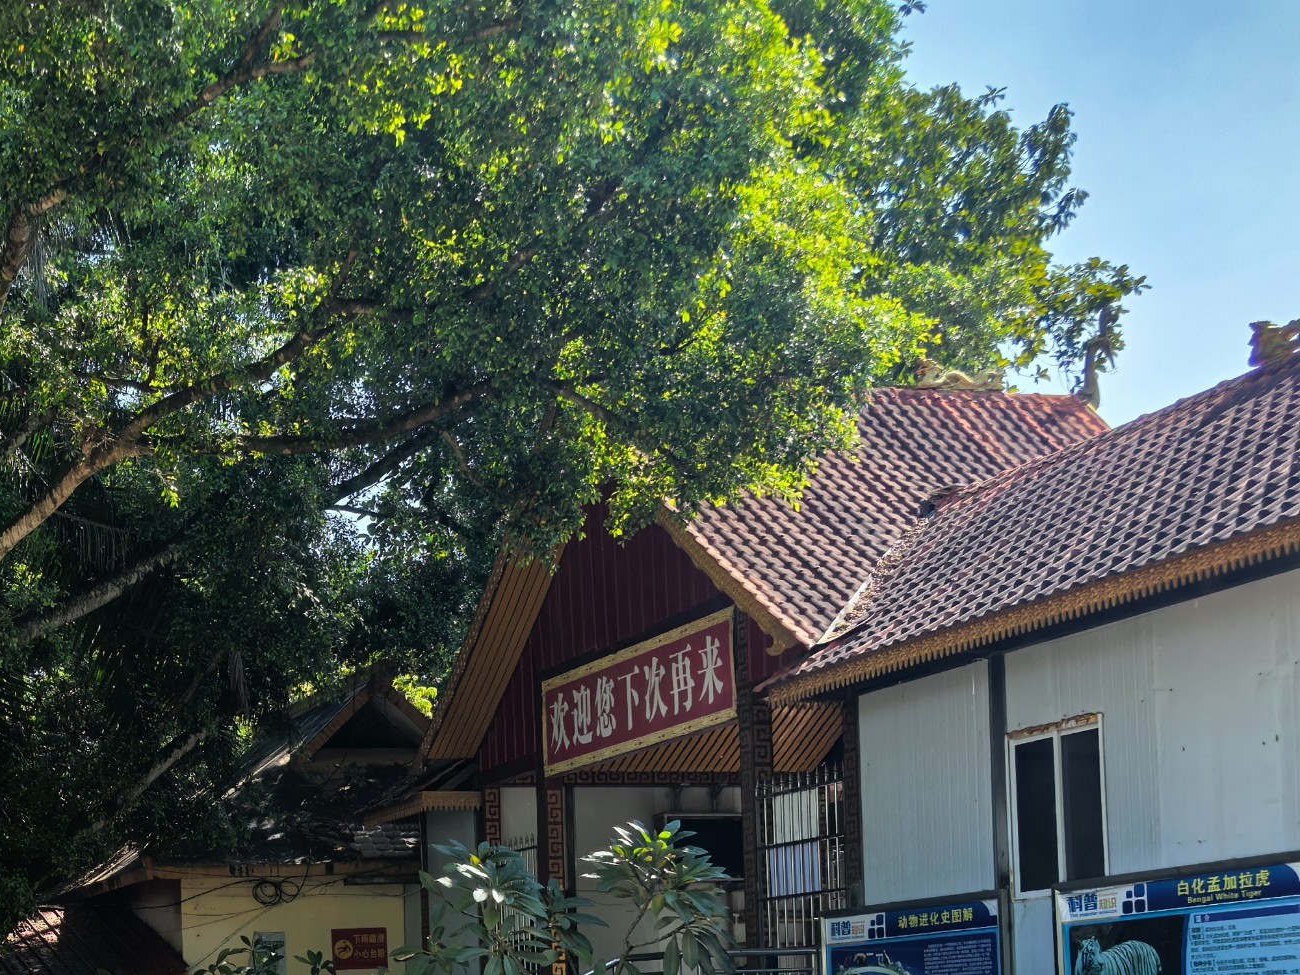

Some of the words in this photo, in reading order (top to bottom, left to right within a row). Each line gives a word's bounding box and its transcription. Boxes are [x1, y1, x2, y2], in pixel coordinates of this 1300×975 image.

[550, 635, 724, 754] 欢迎您下次再来
[1177, 869, 1271, 896] 白化孟加拉虎
[1187, 894, 1214, 904] Bengal
[1215, 891, 1239, 900] White
[1241, 890, 1261, 899] Tiger
[898, 908, 973, 929] 动物进化史图解
[354, 949, 385, 959] 小心台阶
